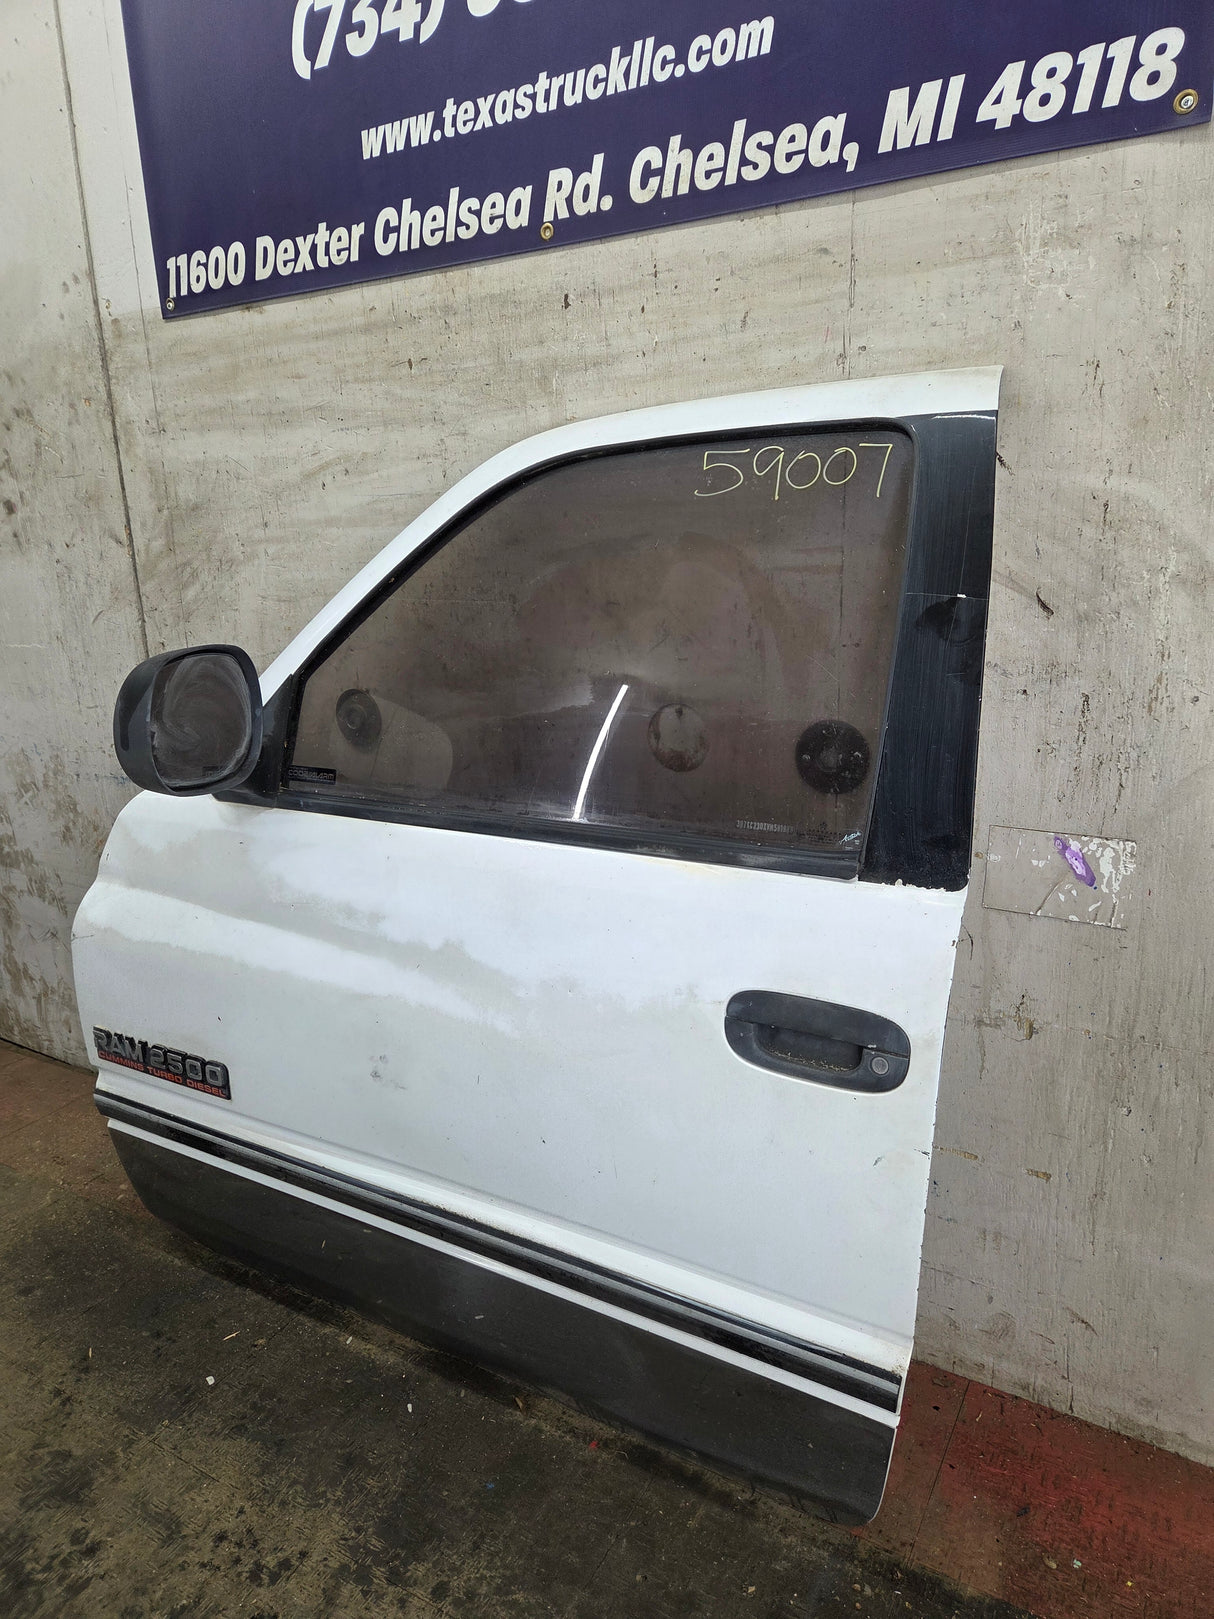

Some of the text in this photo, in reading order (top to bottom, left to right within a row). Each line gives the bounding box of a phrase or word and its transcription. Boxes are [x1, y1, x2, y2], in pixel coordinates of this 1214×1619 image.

[360, 15, 775, 160] www.texastruckllc.com
[166, 26, 1186, 298] 11600 Dexter Chelsea Rd. Chelsea, MI 48118
[694, 443, 893, 500] 59007
[93, 1027, 227, 1088] RAM 2500
[98, 1050, 227, 1098] CUMMINS TURBO DIESEL
